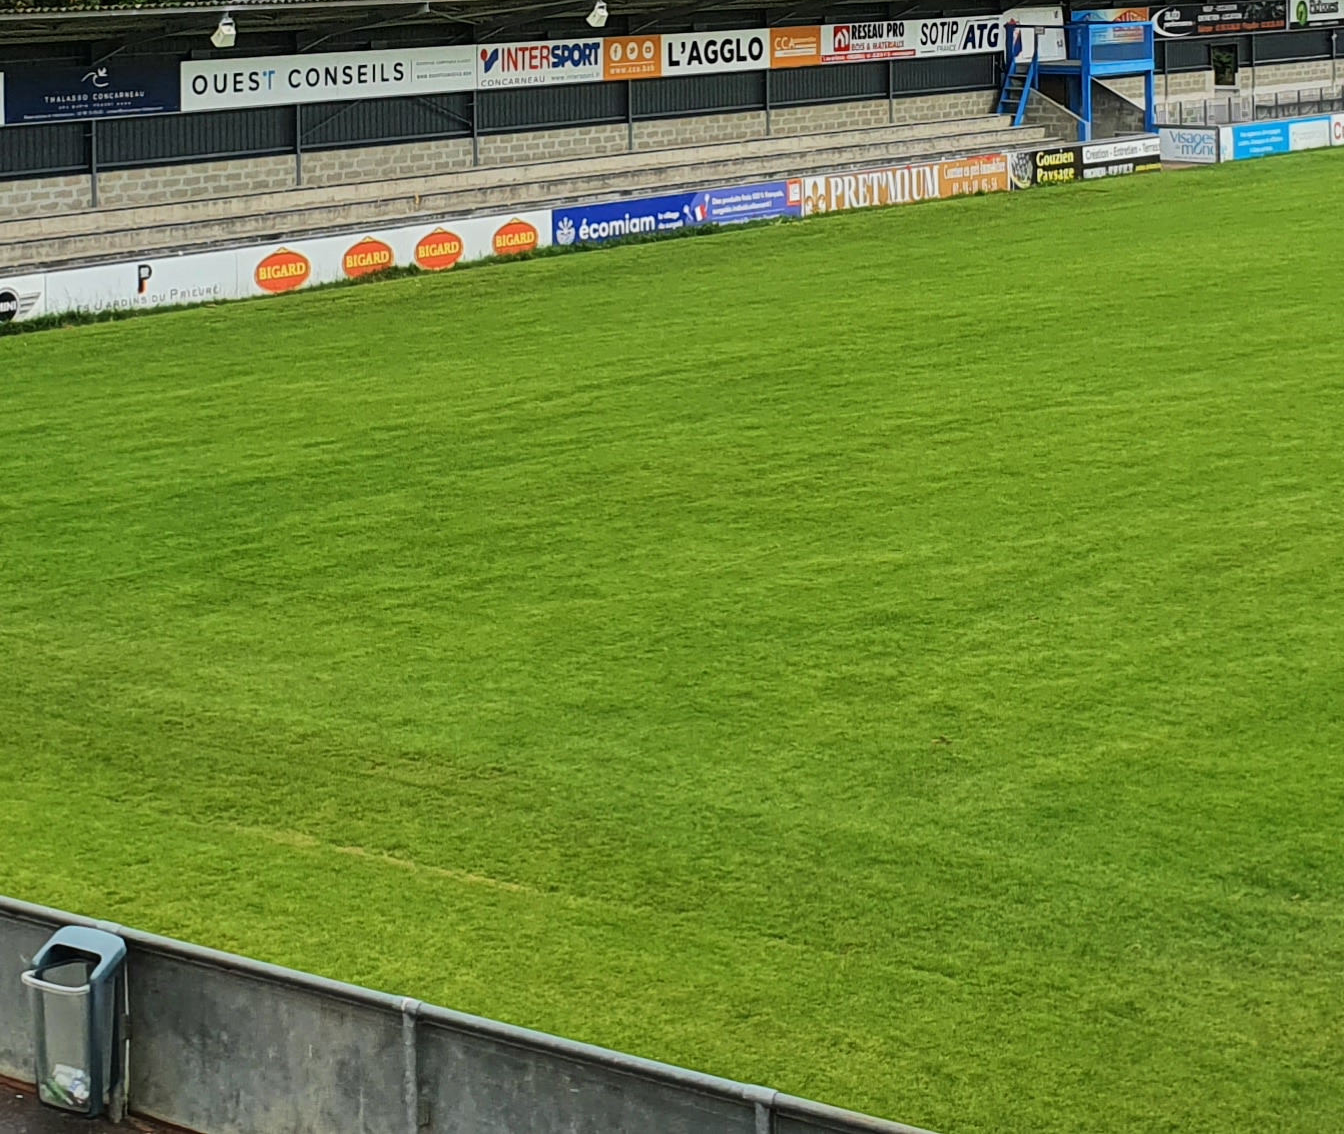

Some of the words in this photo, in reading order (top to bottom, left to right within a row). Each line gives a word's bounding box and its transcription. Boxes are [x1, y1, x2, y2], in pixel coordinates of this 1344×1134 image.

[851, 23, 884, 40] RESEAU
[887, 22, 905, 38] PRO
[920, 21, 959, 46] SOTIP
[962, 23, 1000, 50] ATG
[668, 37, 764, 67] L'AGGLO
[774, 37, 795, 50] CCA
[501, 42, 600, 72] INTERSPORT
[192, 71, 276, 95] OUEST
[288, 62, 405, 88] CONSEILS
[481, 76, 546, 87] CONCARNEAU
[44, 94, 89, 104] THALASSO
[92, 90, 145, 101] CONCARNEAU
[1036, 148, 1074, 166] Gouzien
[1037, 167, 1074, 183] Paysage
[579, 213, 656, 239] écomiam
[495, 232, 534, 248] BIGARD
[418, 241, 459, 258] BIGARD
[346, 250, 390, 268] BIGARD
[259, 262, 306, 280] BIGARD
[94, 296, 147, 310] JARDINS
